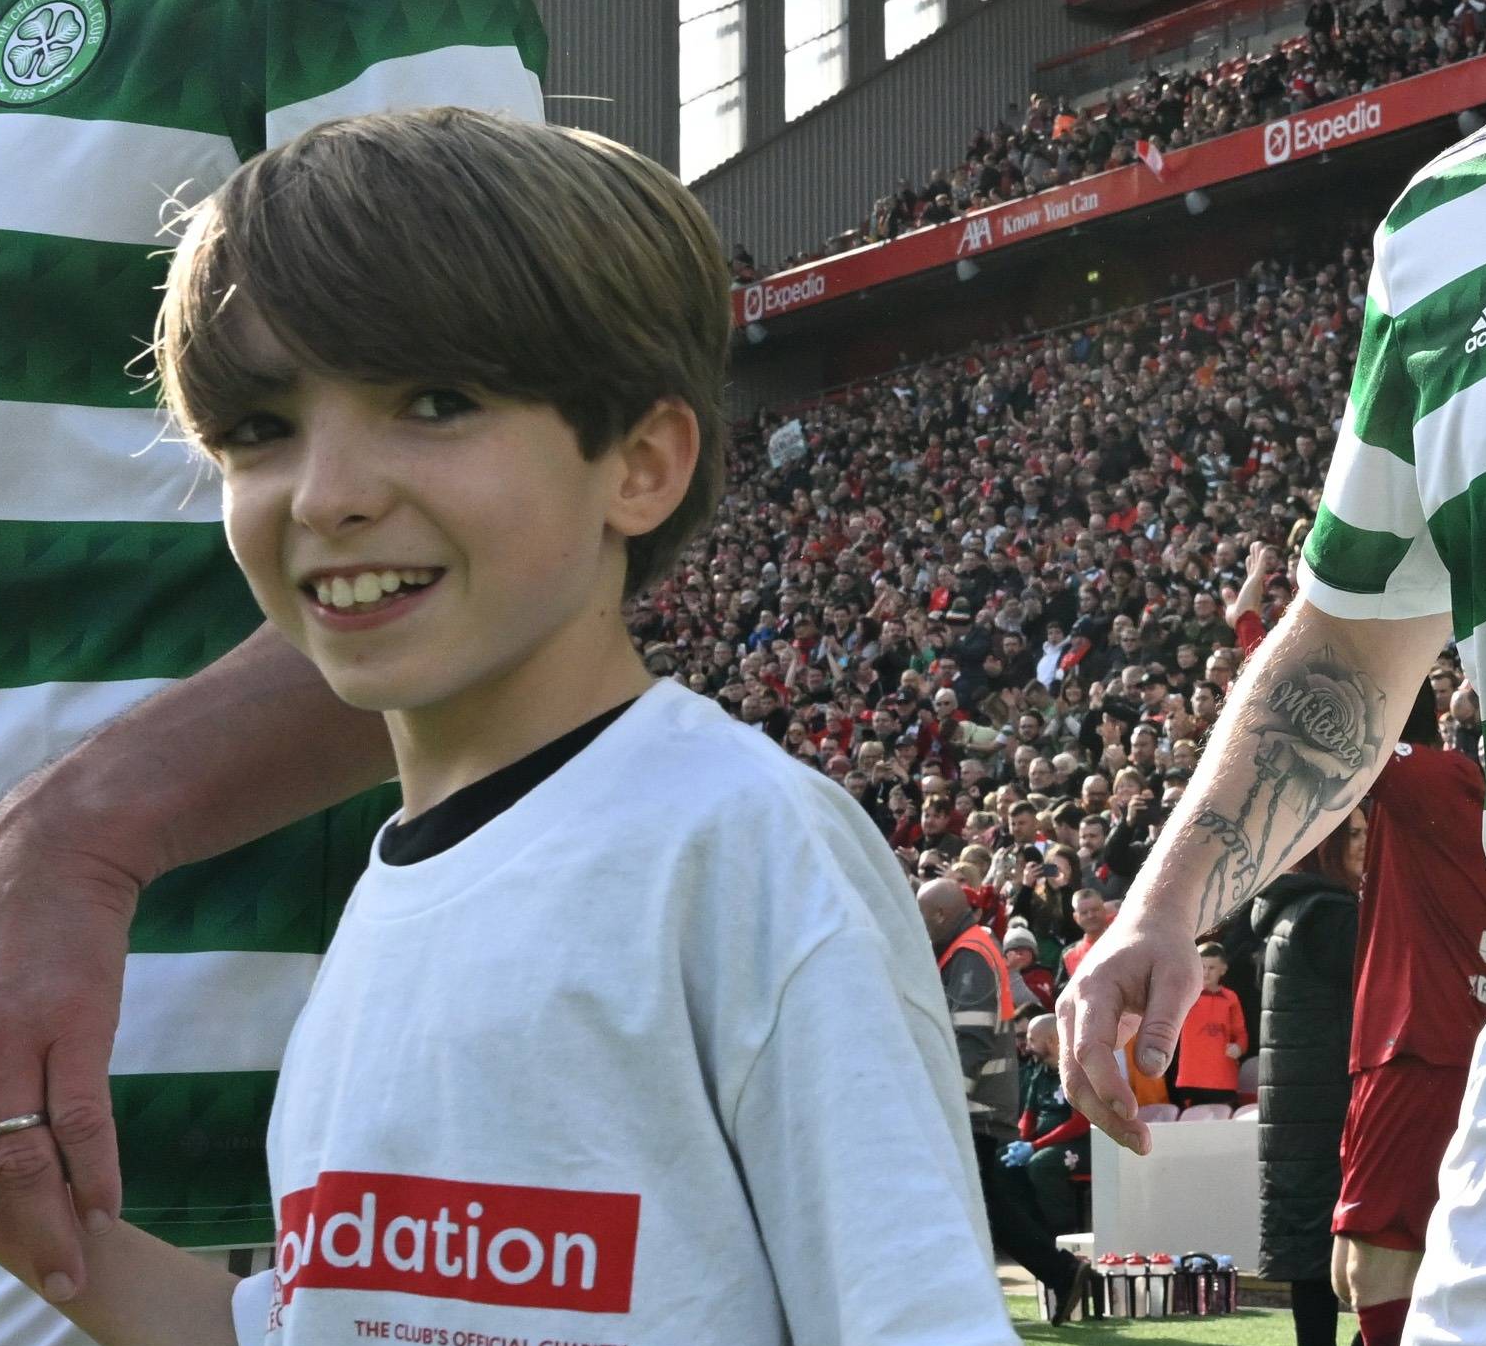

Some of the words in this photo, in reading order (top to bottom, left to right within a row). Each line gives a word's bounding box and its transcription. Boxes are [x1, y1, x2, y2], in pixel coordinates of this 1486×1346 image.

[87, 11, 105, 45] CLUB
[1293, 100, 1382, 152] Expedia
[957, 217, 993, 255] AXA
[1001, 214, 1040, 236] Know
[1042, 201, 1071, 223] You
[1071, 192, 1099, 212] Can
[765, 272, 826, 311] Expedia
[354, 1320, 391, 1339] THE
[394, 1323, 449, 1346] CLUB'S
